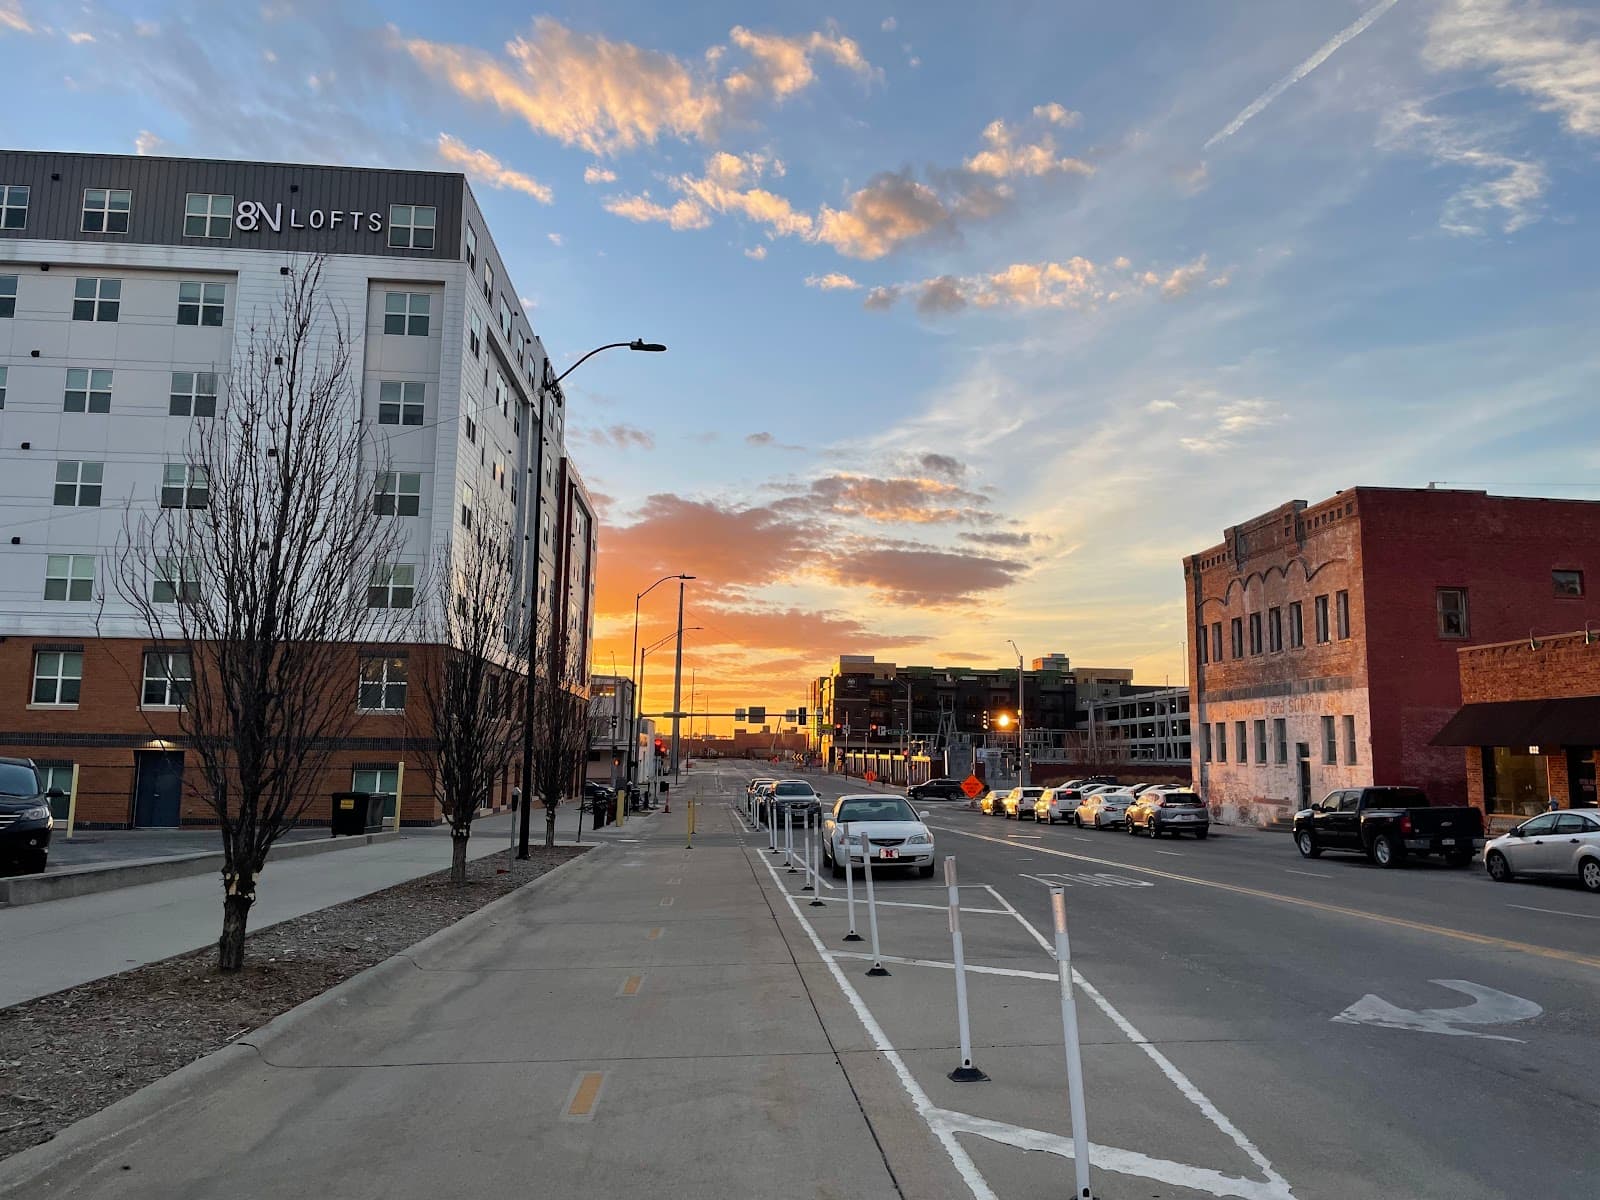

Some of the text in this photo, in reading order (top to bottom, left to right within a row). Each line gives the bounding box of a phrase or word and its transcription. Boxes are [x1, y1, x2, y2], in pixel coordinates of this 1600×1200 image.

[235, 200, 383, 232] 8N LOFTS
[885, 849, 893, 857] N
